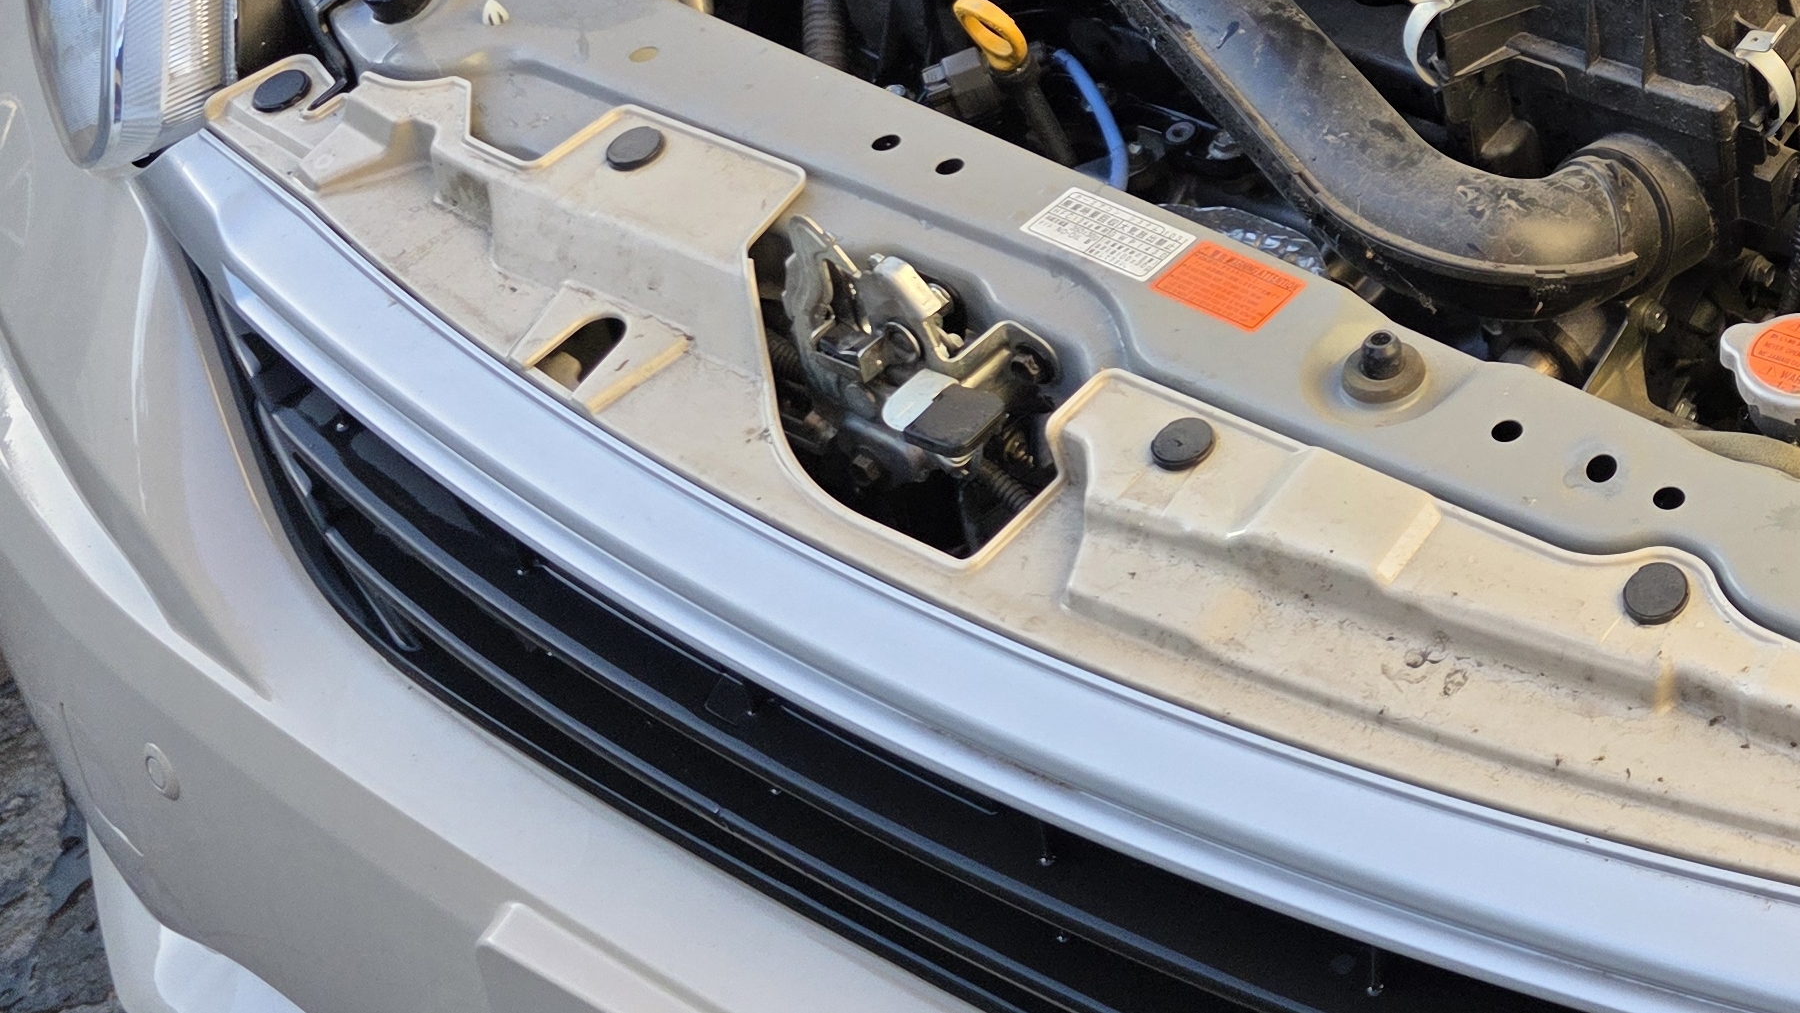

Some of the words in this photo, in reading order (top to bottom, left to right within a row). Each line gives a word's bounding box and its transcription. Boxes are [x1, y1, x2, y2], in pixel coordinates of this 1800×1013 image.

[1257, 266, 1302, 292] ATTENTION
[1763, 341, 1785, 352] NEVER
[1757, 349, 1768, 357] NE
[1766, 351, 1791, 365] JAMAIS
